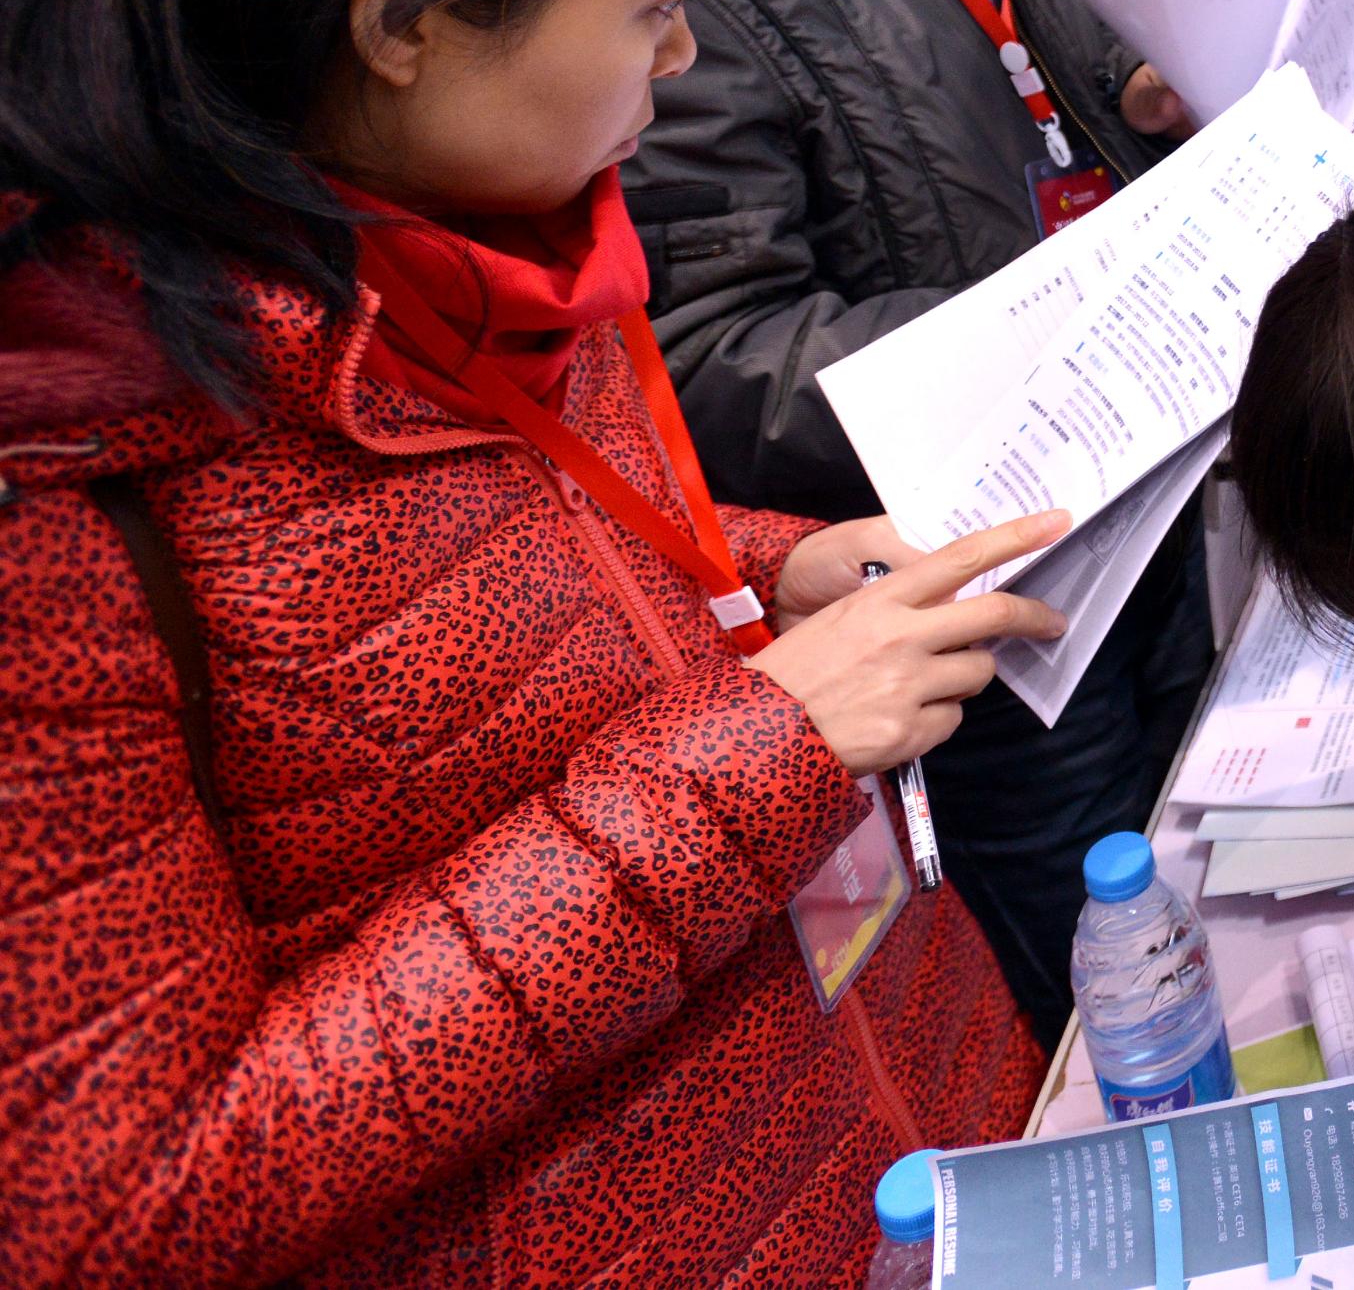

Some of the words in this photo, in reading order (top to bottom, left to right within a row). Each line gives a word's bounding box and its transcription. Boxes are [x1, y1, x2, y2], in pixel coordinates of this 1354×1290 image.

[1151, 1139, 1174, 1215] 自我评价
[1257, 1118, 1281, 1194] 技能证书
[941, 1168, 958, 1225] PERSONAL
[943, 1226, 958, 1278] RESUME
